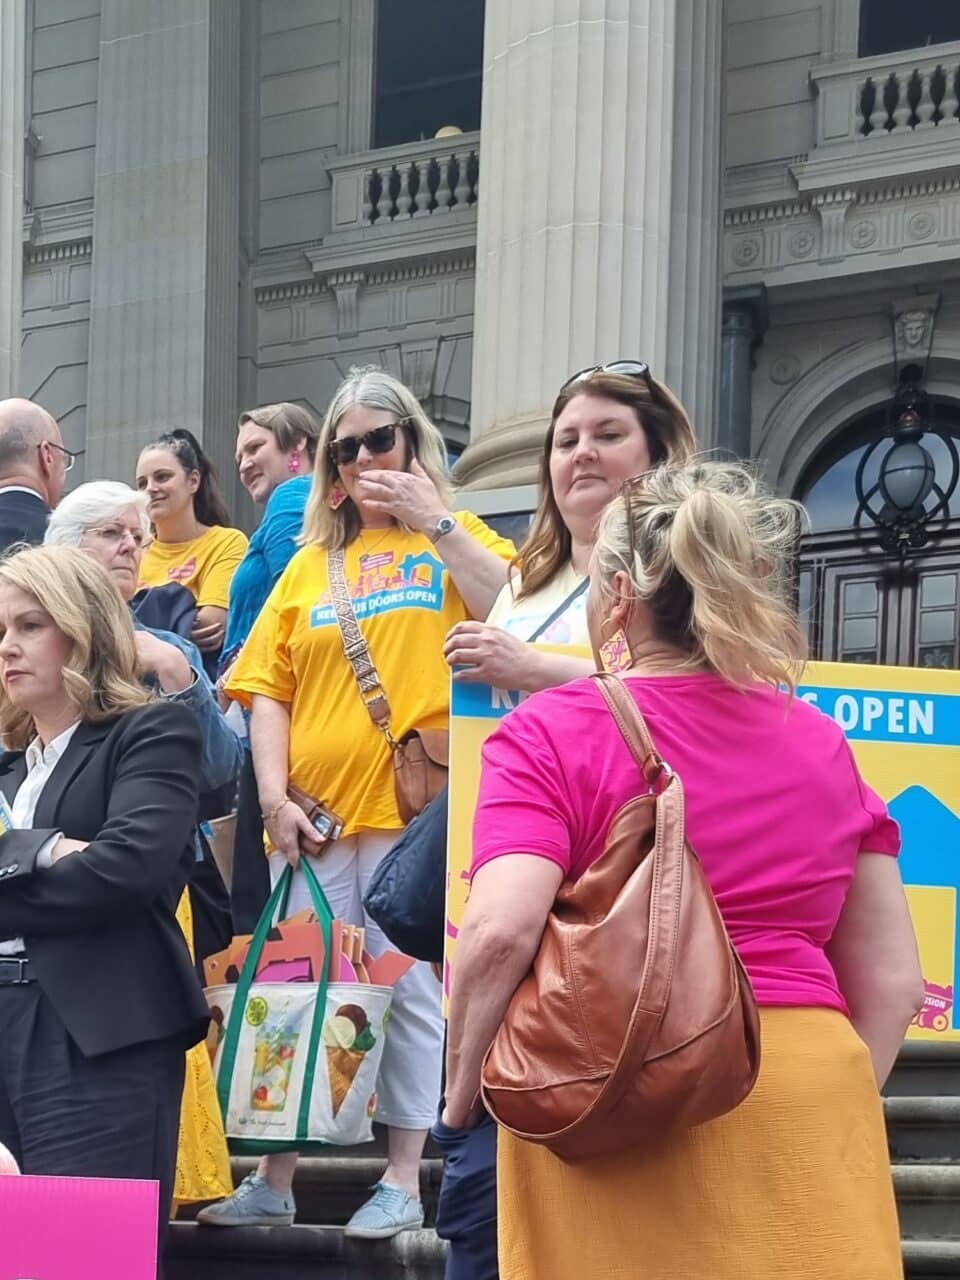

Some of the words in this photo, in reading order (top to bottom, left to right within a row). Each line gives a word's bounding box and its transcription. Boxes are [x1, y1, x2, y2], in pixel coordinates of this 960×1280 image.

[368, 591, 405, 610] DOORS
[406, 590, 436, 604] OPEN
[834, 694, 934, 735] OPEN
